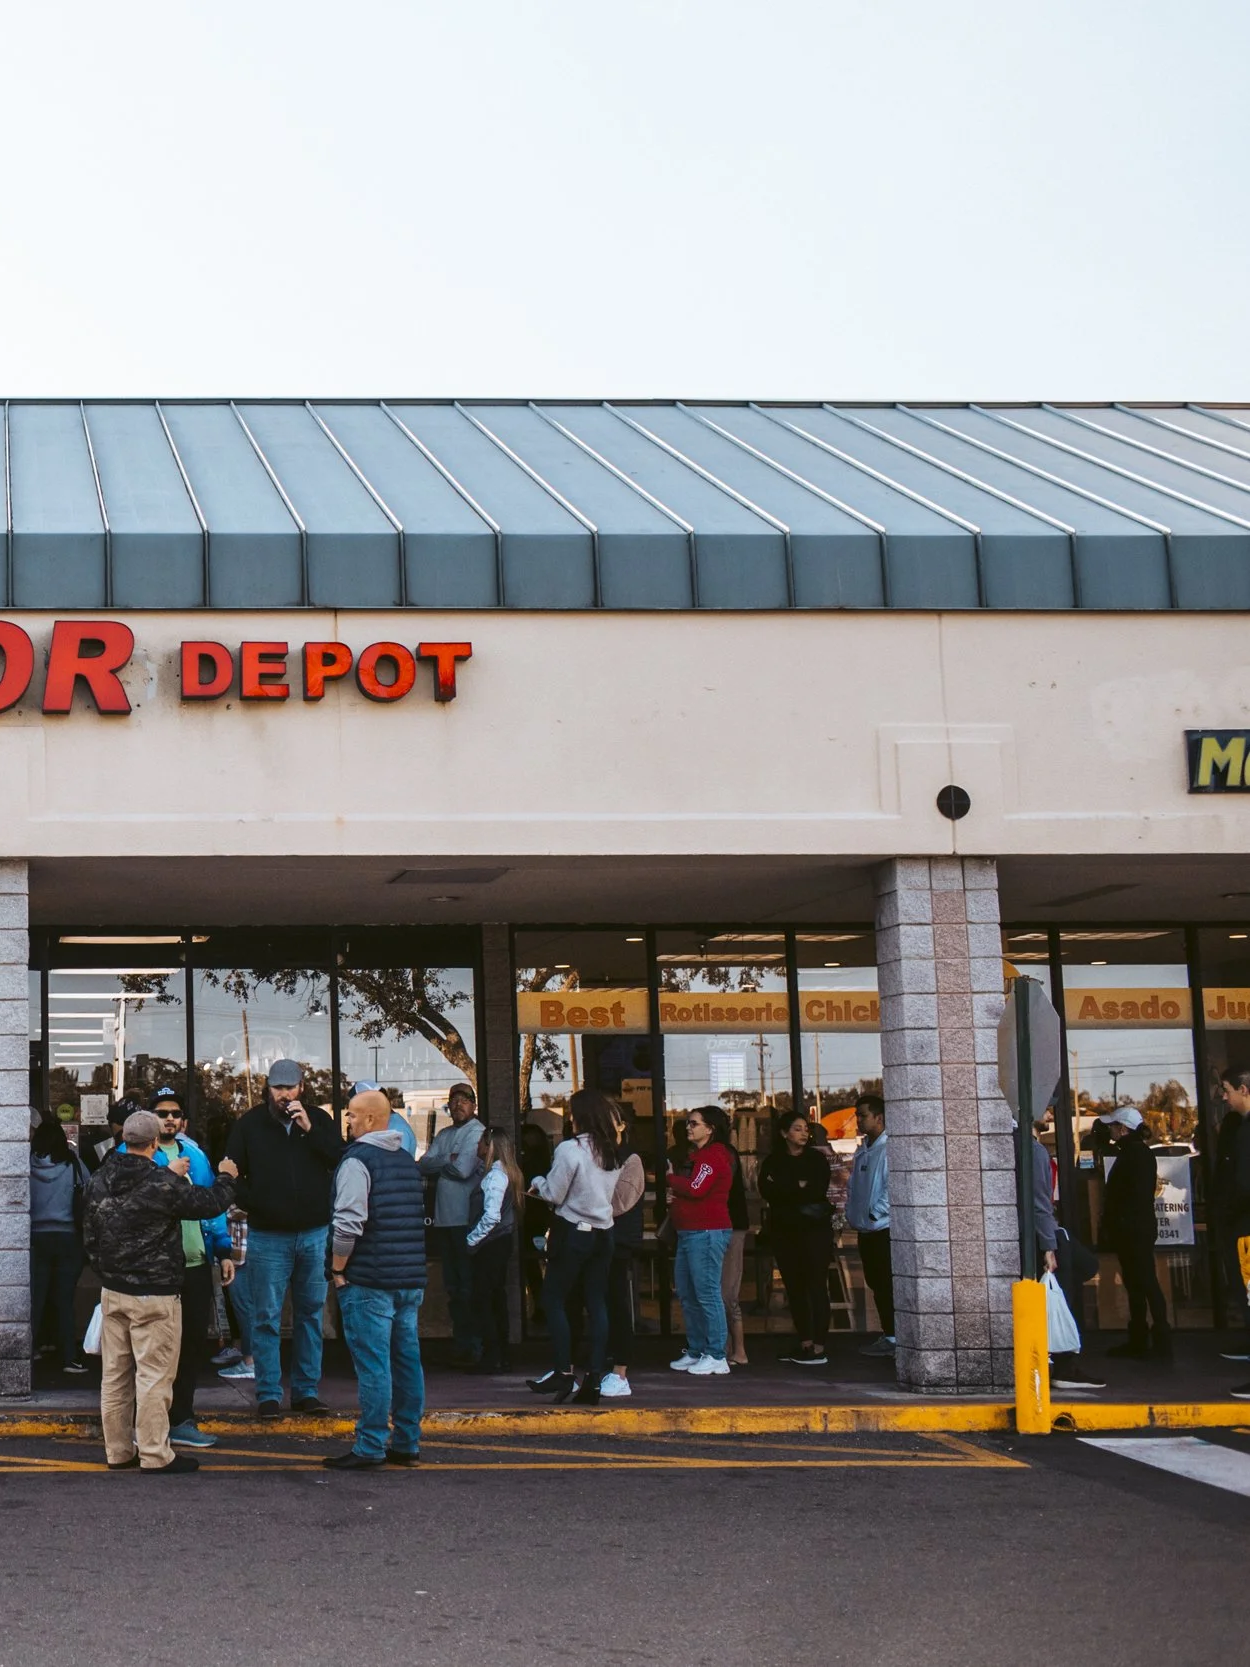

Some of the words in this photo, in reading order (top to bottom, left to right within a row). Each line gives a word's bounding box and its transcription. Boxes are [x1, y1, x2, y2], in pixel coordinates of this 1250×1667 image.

[180, 641, 473, 702] DEPOT
[1197, 737, 1250, 787] M
[539, 1000, 626, 1028] Best
[660, 1002, 789, 1023] Rotisserie
[1078, 995, 1181, 1021] Asado
[1154, 1202, 1190, 1213] ATERING
